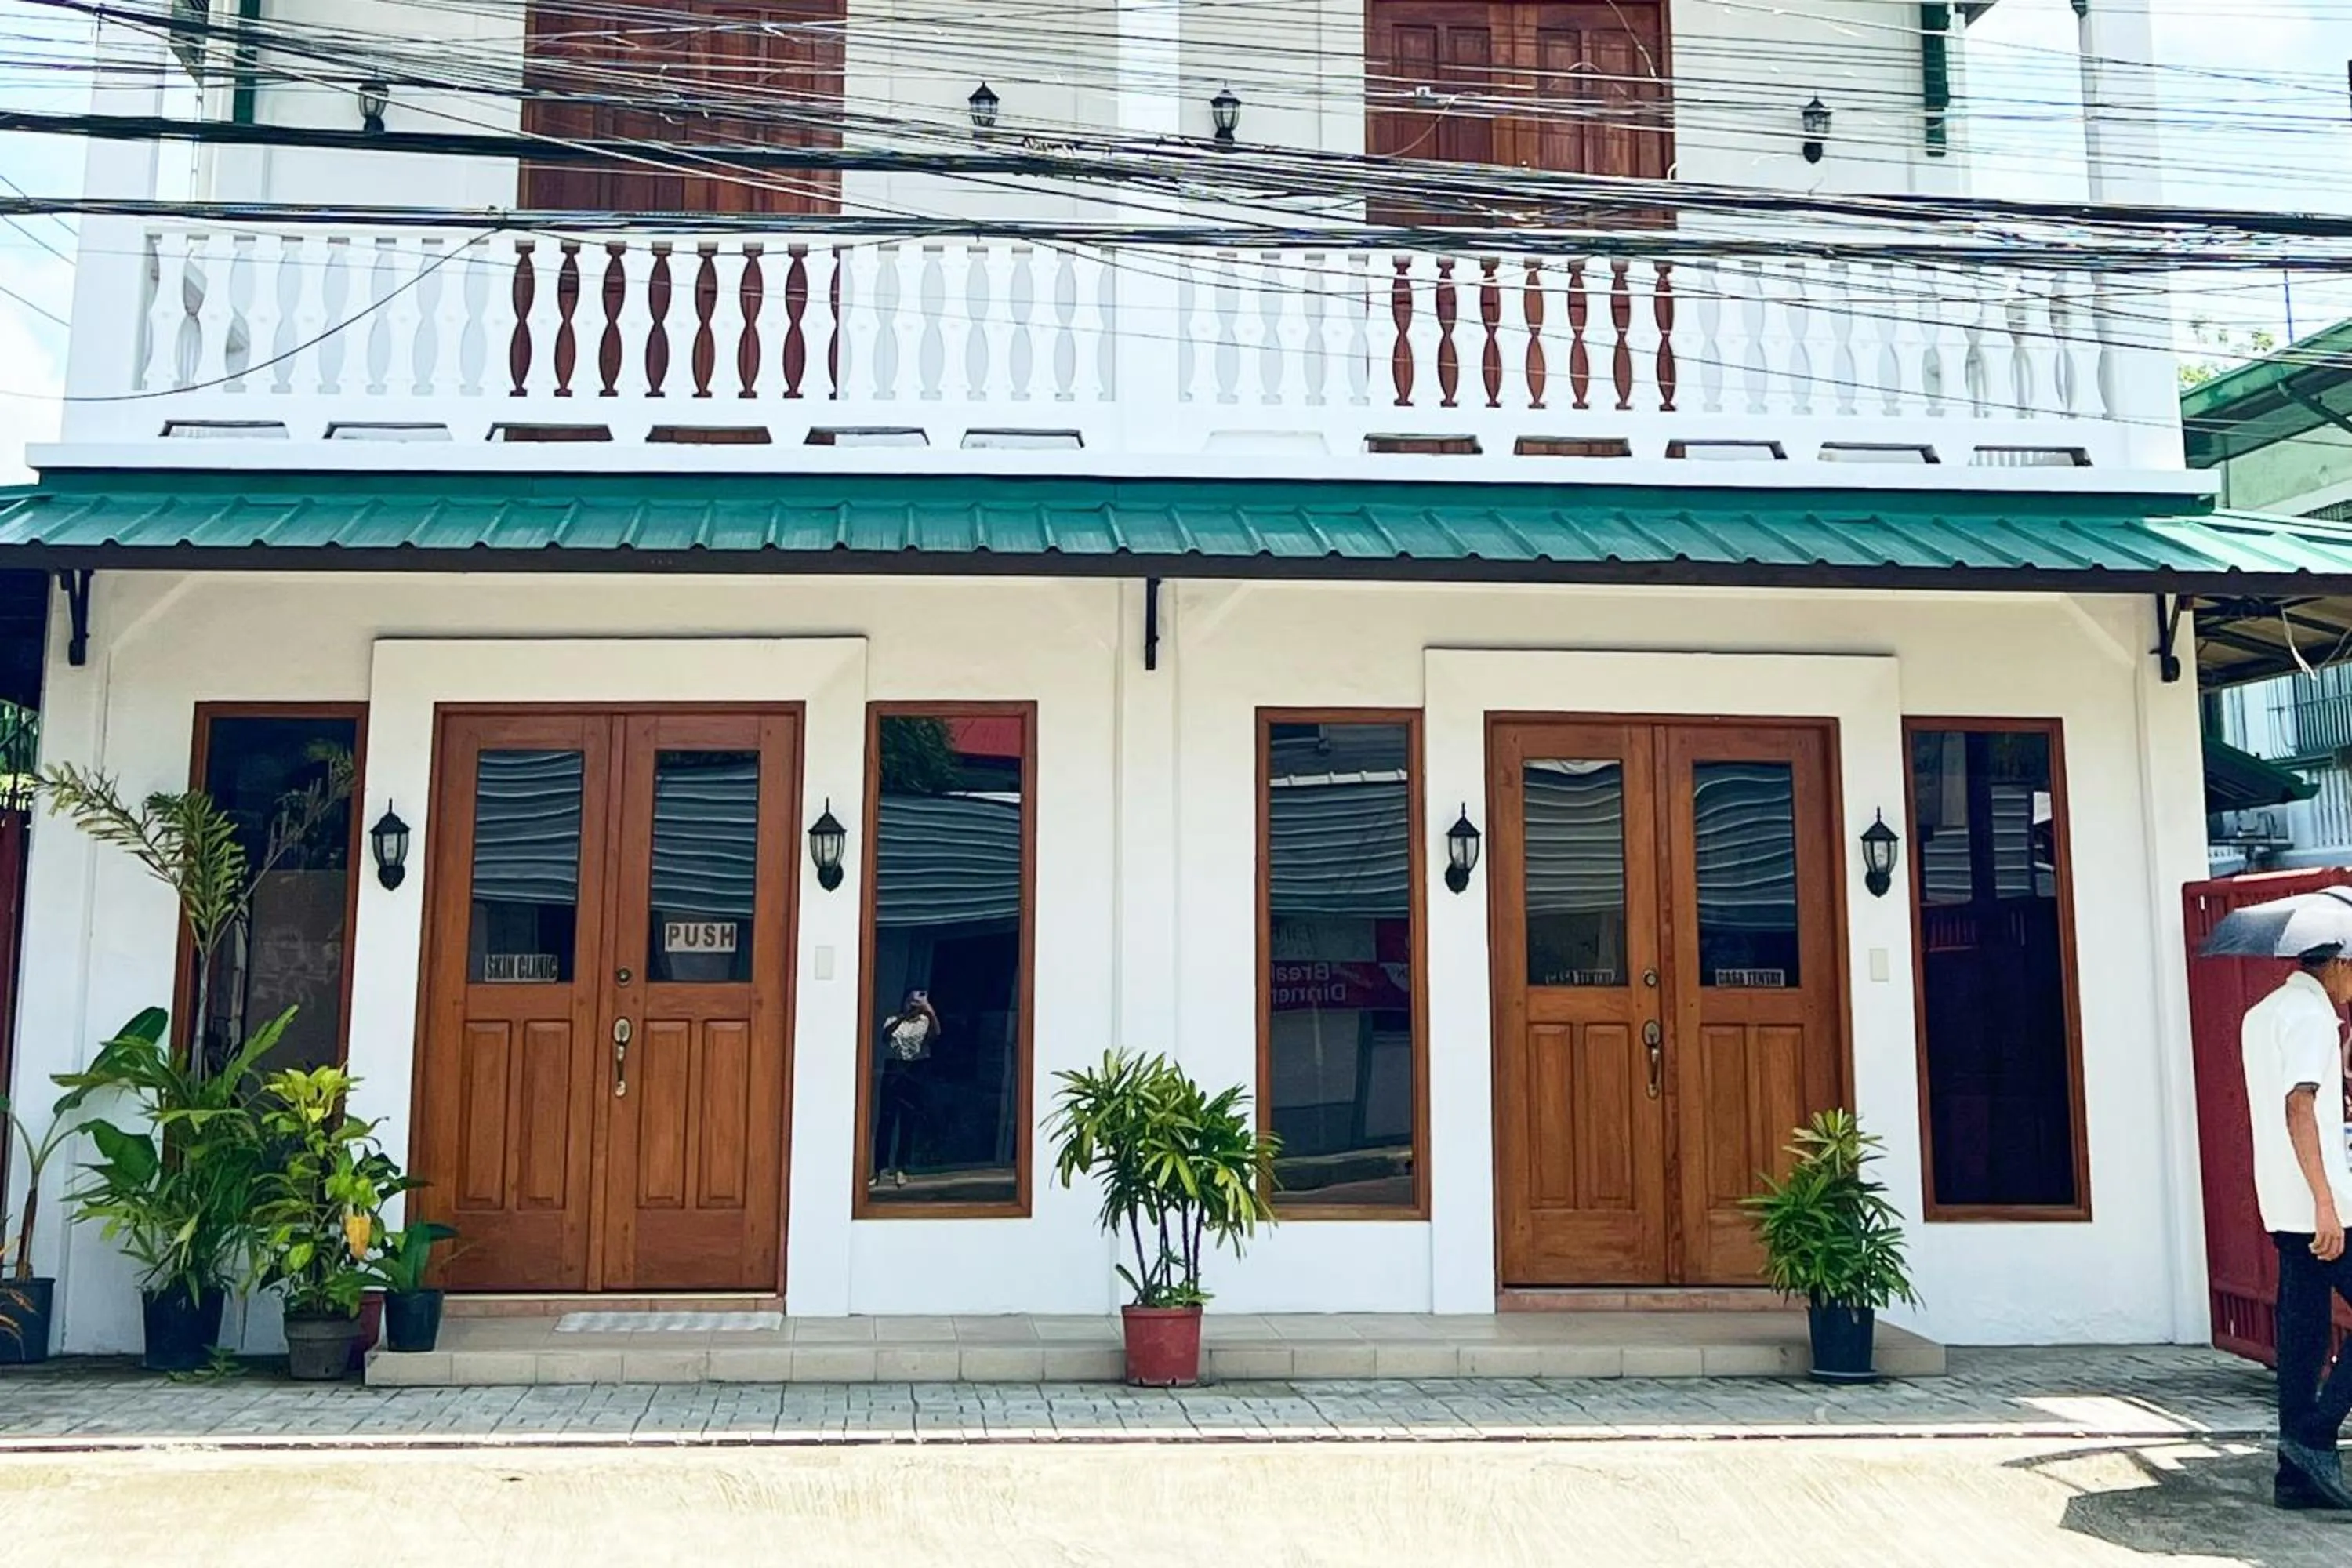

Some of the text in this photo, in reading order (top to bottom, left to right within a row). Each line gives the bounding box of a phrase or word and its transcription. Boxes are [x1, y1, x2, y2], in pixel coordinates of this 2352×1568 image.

[667, 924, 735, 948] PUSH
[487, 955, 557, 979] SKIN CLINIC
